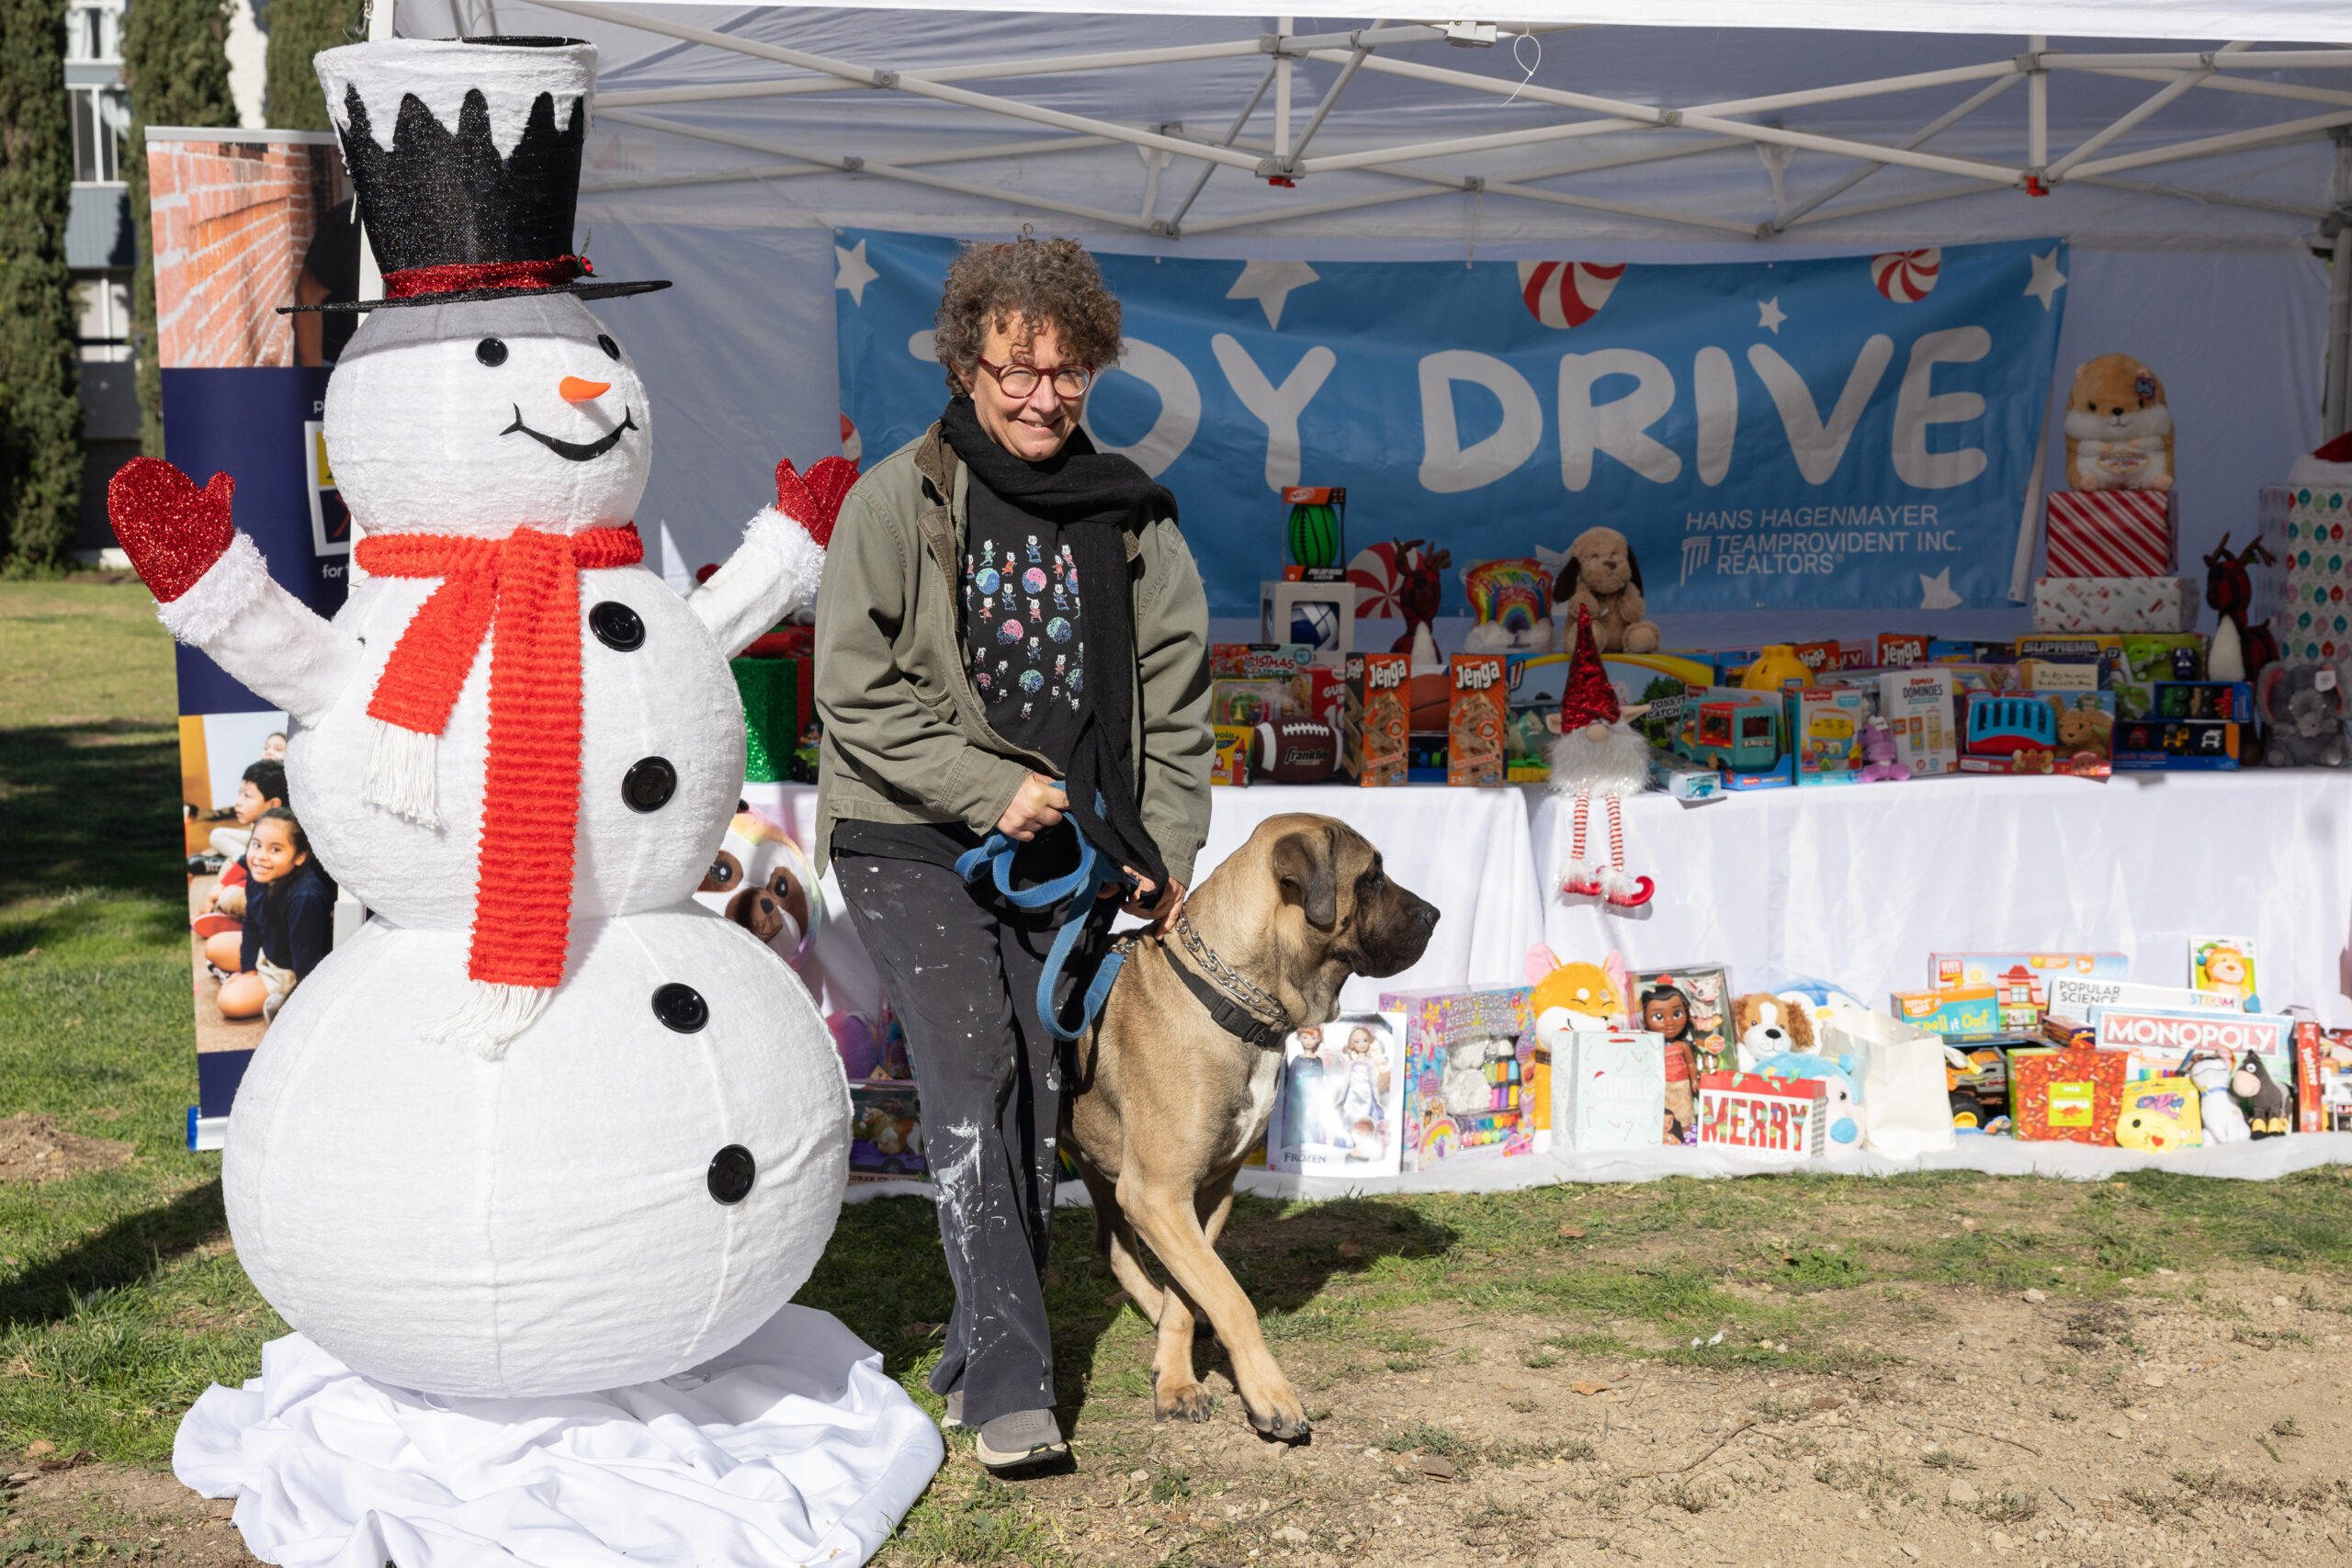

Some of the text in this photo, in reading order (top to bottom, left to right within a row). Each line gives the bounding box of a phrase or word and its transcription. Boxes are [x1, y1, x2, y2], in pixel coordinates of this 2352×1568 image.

[910, 325, 1992, 494] OY DRIVE
[1288, 488, 1316, 502] NERF
[1685, 504, 1939, 532] HANS HAGENMAYER
[1716, 530, 1962, 554] TEAMPROVIDENT INC.
[322, 564, 344, 579] for
[1882, 640, 1922, 667] Jenga
[2022, 641, 2098, 653] SUPREME
[1799, 648, 1826, 669] Jenga
[1369, 660, 1408, 689] Jenga
[1455, 660, 1501, 690] Jenga
[1323, 684, 1345, 698] GUE
[1903, 683, 1944, 698] DOMINOES
[1647, 706, 1679, 718] CATCH
[1650, 697, 1676, 709] TOSS
[2059, 980, 2121, 996] POPULAR
[1453, 995, 1509, 1012] PAINT STUDIO
[2061, 992, 2119, 1005] SCIENCE
[1445, 1009, 1517, 1030] ATELIER PEINTURE
[1962, 1010, 1989, 1030] Out
[1444, 1025, 1476, 1044] ESTUDIO
[1486, 1022, 1519, 1034] PINTURA
[2107, 1018, 2275, 1053] MONOPOLY
[1597, 1077, 1654, 1100] JINGLE
[1701, 1094, 1809, 1152] MERRY
[1283, 1152, 1327, 1164] FROZEN
